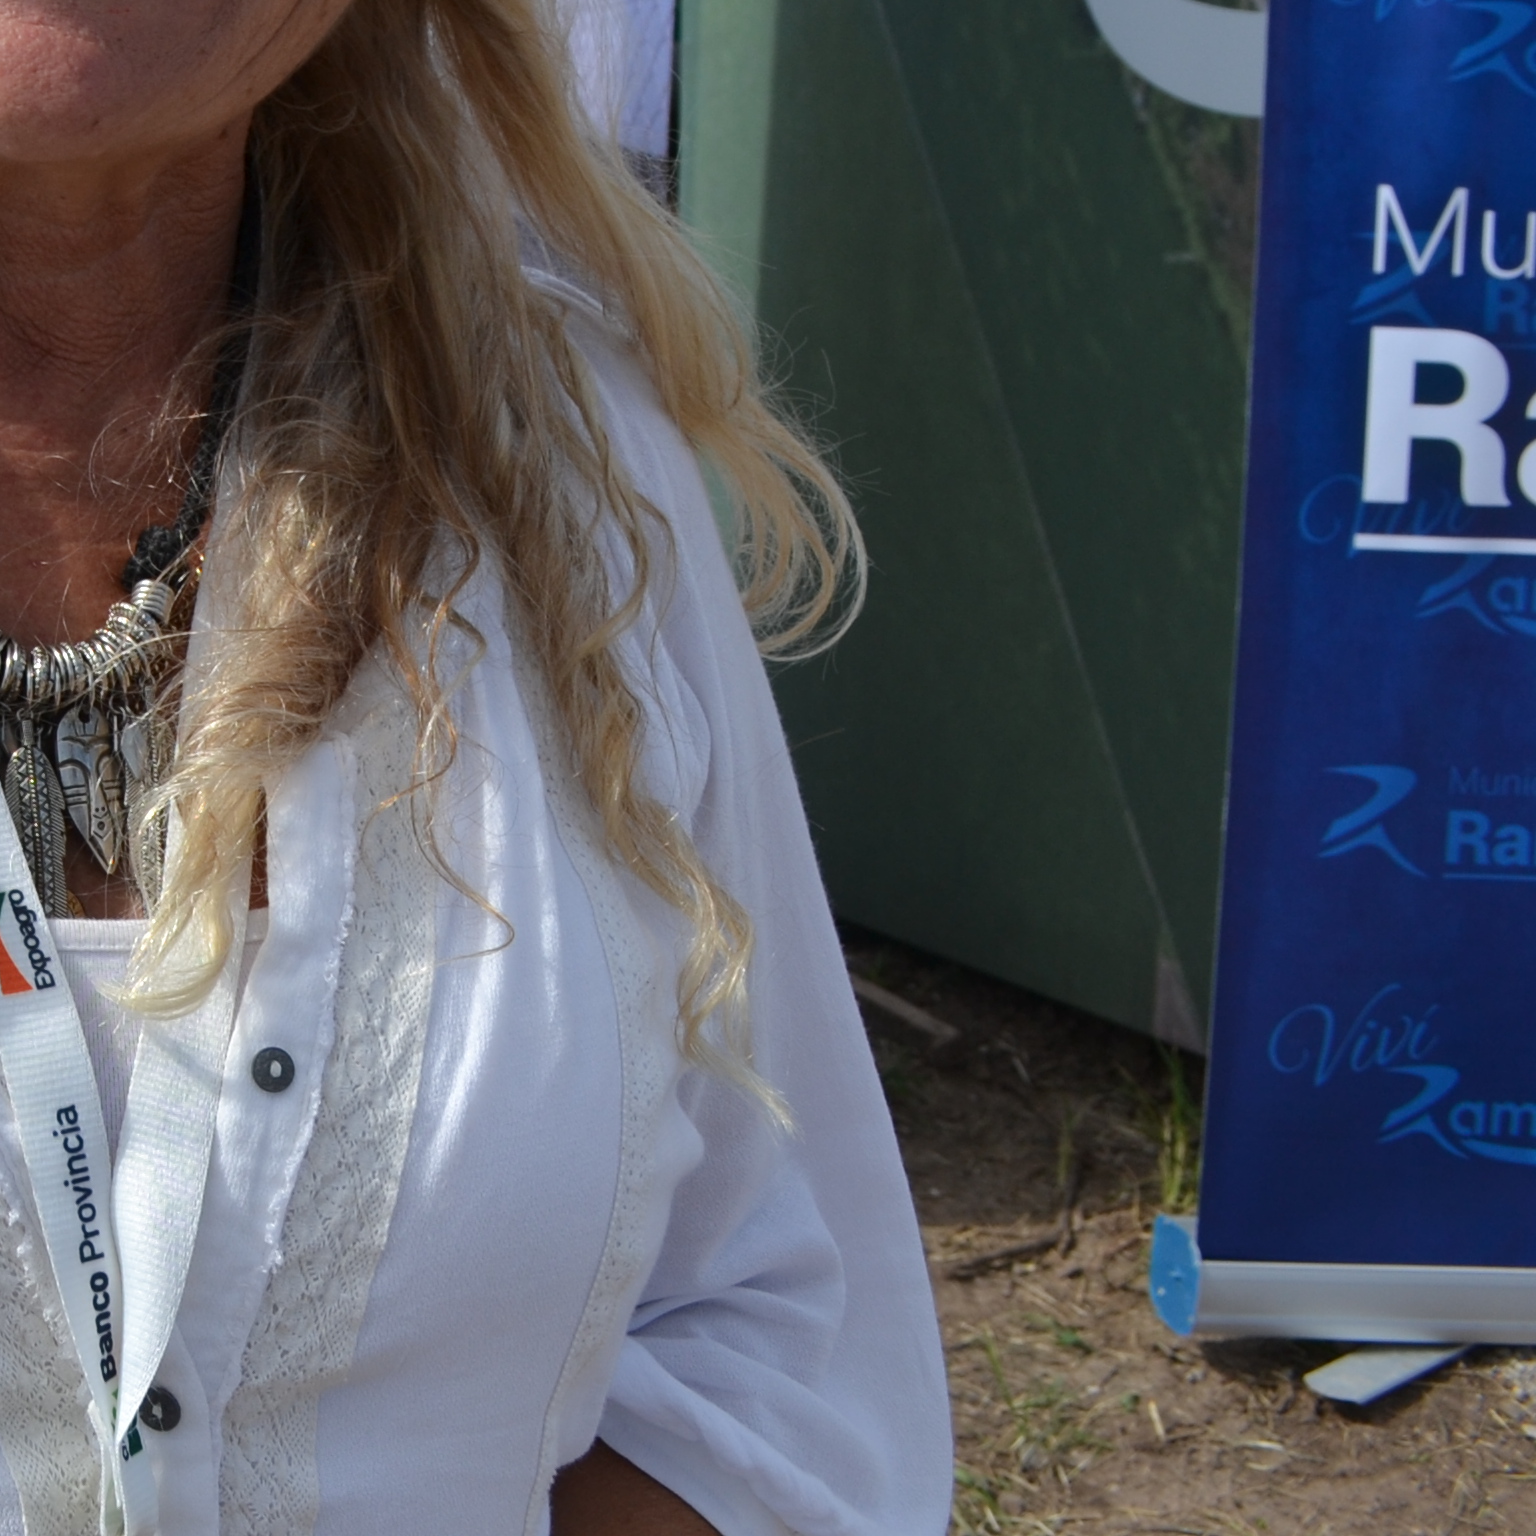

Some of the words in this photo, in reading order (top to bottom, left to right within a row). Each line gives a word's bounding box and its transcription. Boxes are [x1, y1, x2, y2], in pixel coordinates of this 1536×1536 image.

[1361, 324, 1536, 508] R
[8, 888, 55, 990] Expoagro
[52, 1104, 104, 1264] Provincia
[89, 1270, 117, 1382] Banco
